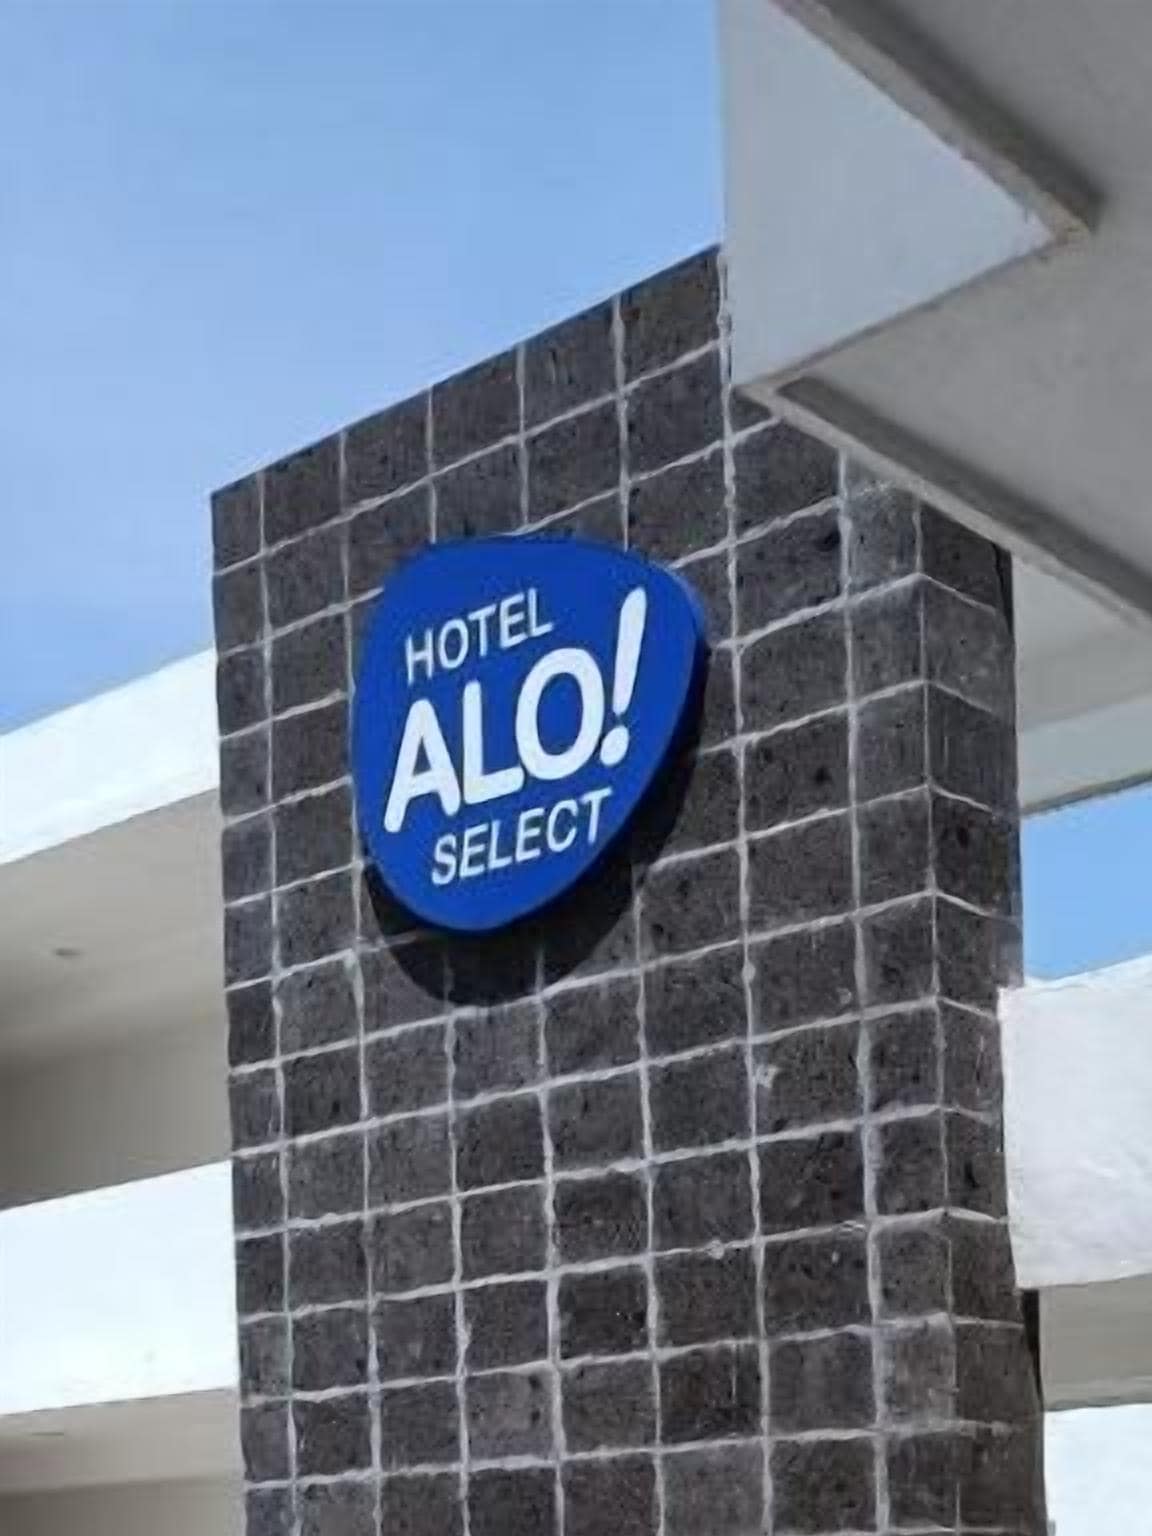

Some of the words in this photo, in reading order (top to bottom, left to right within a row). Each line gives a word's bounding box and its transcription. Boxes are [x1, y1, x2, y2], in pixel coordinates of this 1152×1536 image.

[405, 588, 554, 685] HOTEL
[384, 587, 647, 833] ALO!
[431, 786, 613, 886] SELECT
